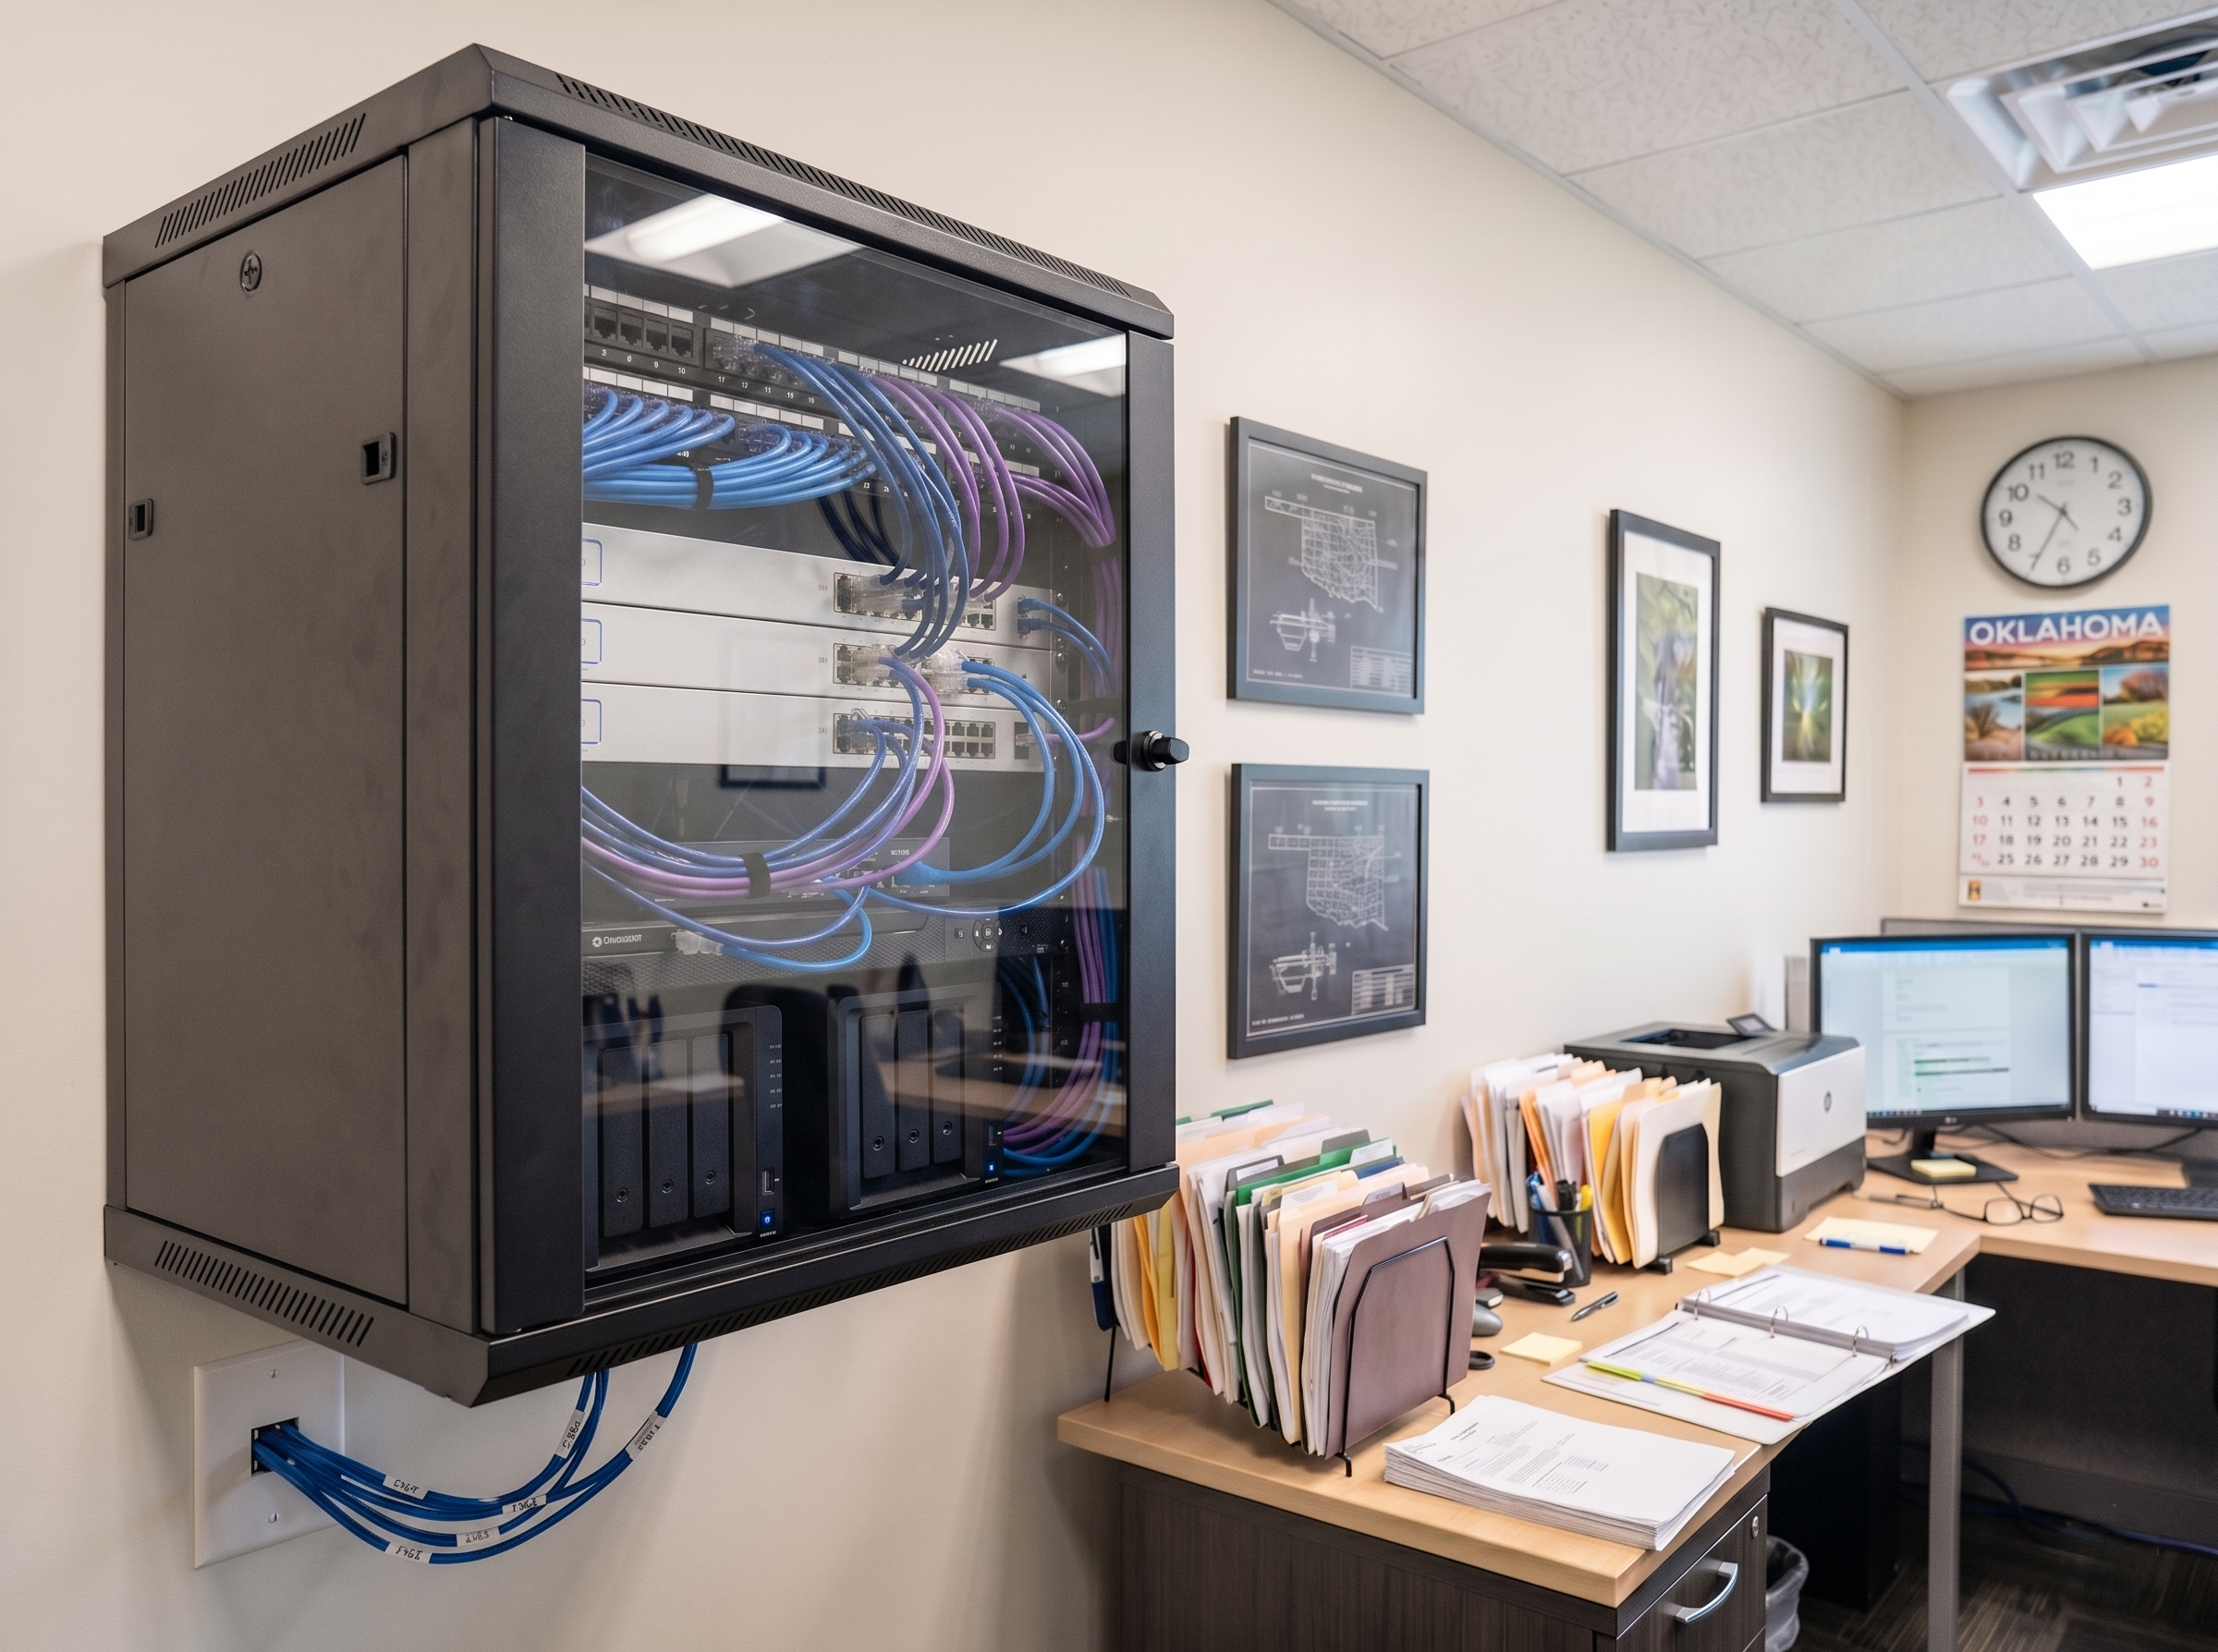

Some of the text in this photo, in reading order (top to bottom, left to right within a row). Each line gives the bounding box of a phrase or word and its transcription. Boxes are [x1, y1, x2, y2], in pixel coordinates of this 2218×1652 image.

[2054, 451, 2075, 469] 12
[2090, 456, 2099, 474] 1
[2029, 463, 2045, 480] 11
[2108, 471, 2123, 491] 2
[2007, 482, 2029, 503] 10
[2117, 497, 2132, 516] 3
[1999, 509, 2013, 528] 9
[2008, 532, 2021, 553] 8
[2108, 527, 2122, 543] 4
[2057, 556, 2071, 576] 6
[2087, 548, 2101, 567] 5
[1969, 612, 2164, 646] OKLAHOMA
[2116, 774, 2152, 789] 1 2
[1977, 795, 2155, 808] 3 4 5 6 7 8 9
[1972, 814, 2158, 828] 10 11 12 13 14 15 16
[1972, 833, 2158, 849] 17 18 19 20 21 22 23
[1997, 853, 2015, 866] 25
[2025, 854, 2042, 866] 26
[2053, 854, 2070, 867] 27
[2080, 855, 2099, 868] 28
[2110, 856, 2128, 869] 29
[2140, 856, 2159, 869] 30
